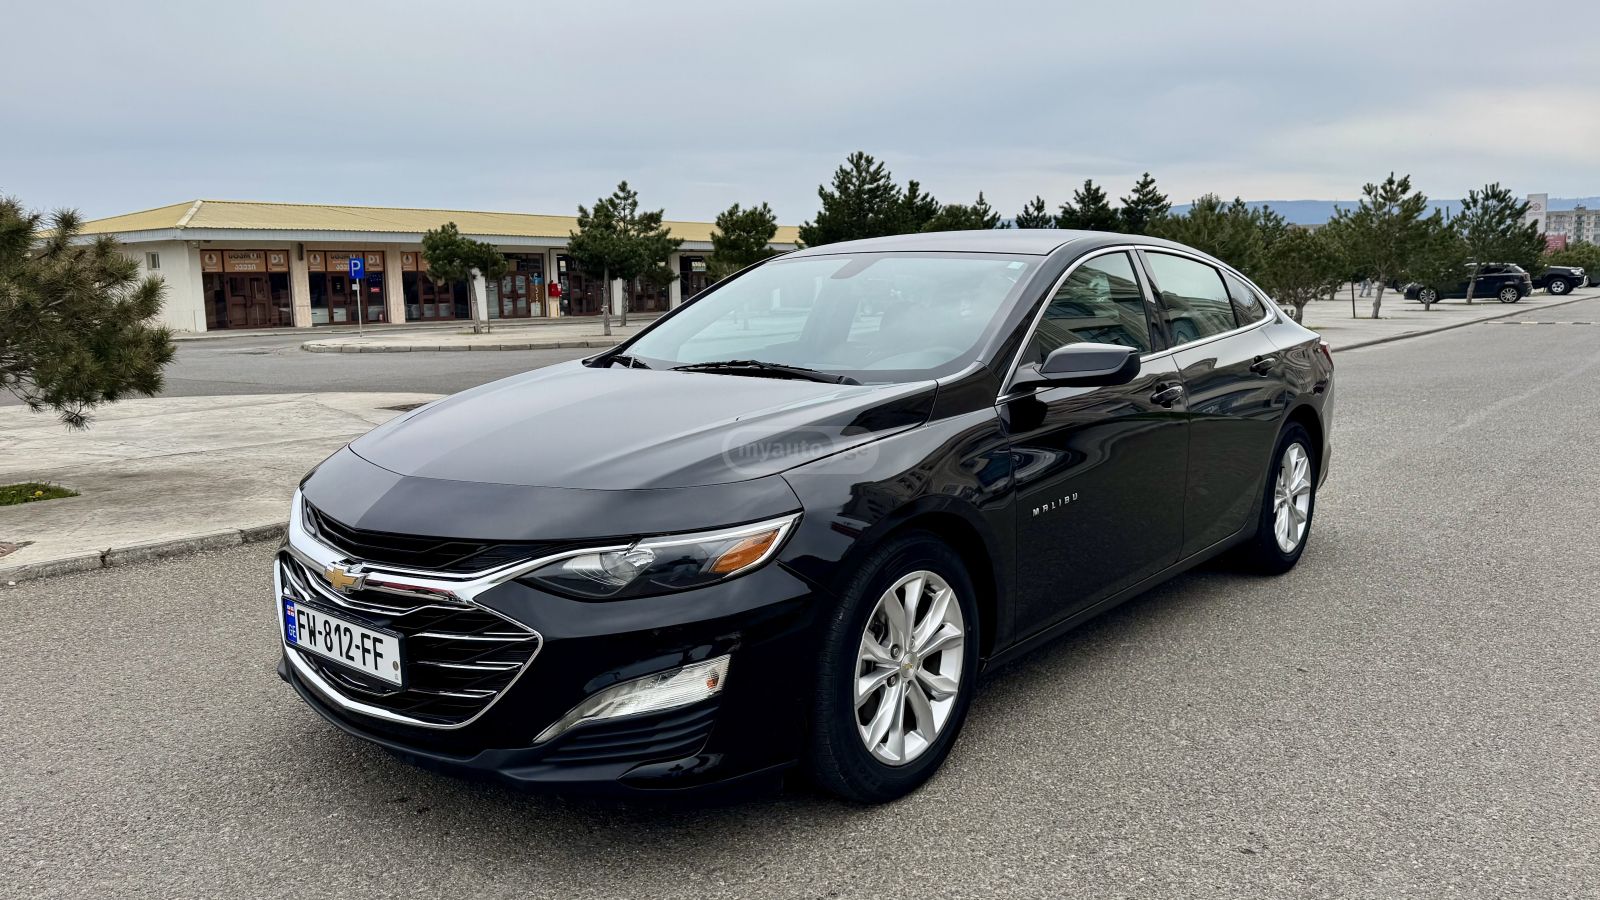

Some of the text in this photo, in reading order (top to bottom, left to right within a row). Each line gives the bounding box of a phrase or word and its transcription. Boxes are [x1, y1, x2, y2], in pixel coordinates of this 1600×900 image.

[351, 260, 361, 276] P
[1032, 492, 1078, 517] MALIBU
[288, 624, 297, 638] GE
[297, 609, 384, 670] FW-812-FF
